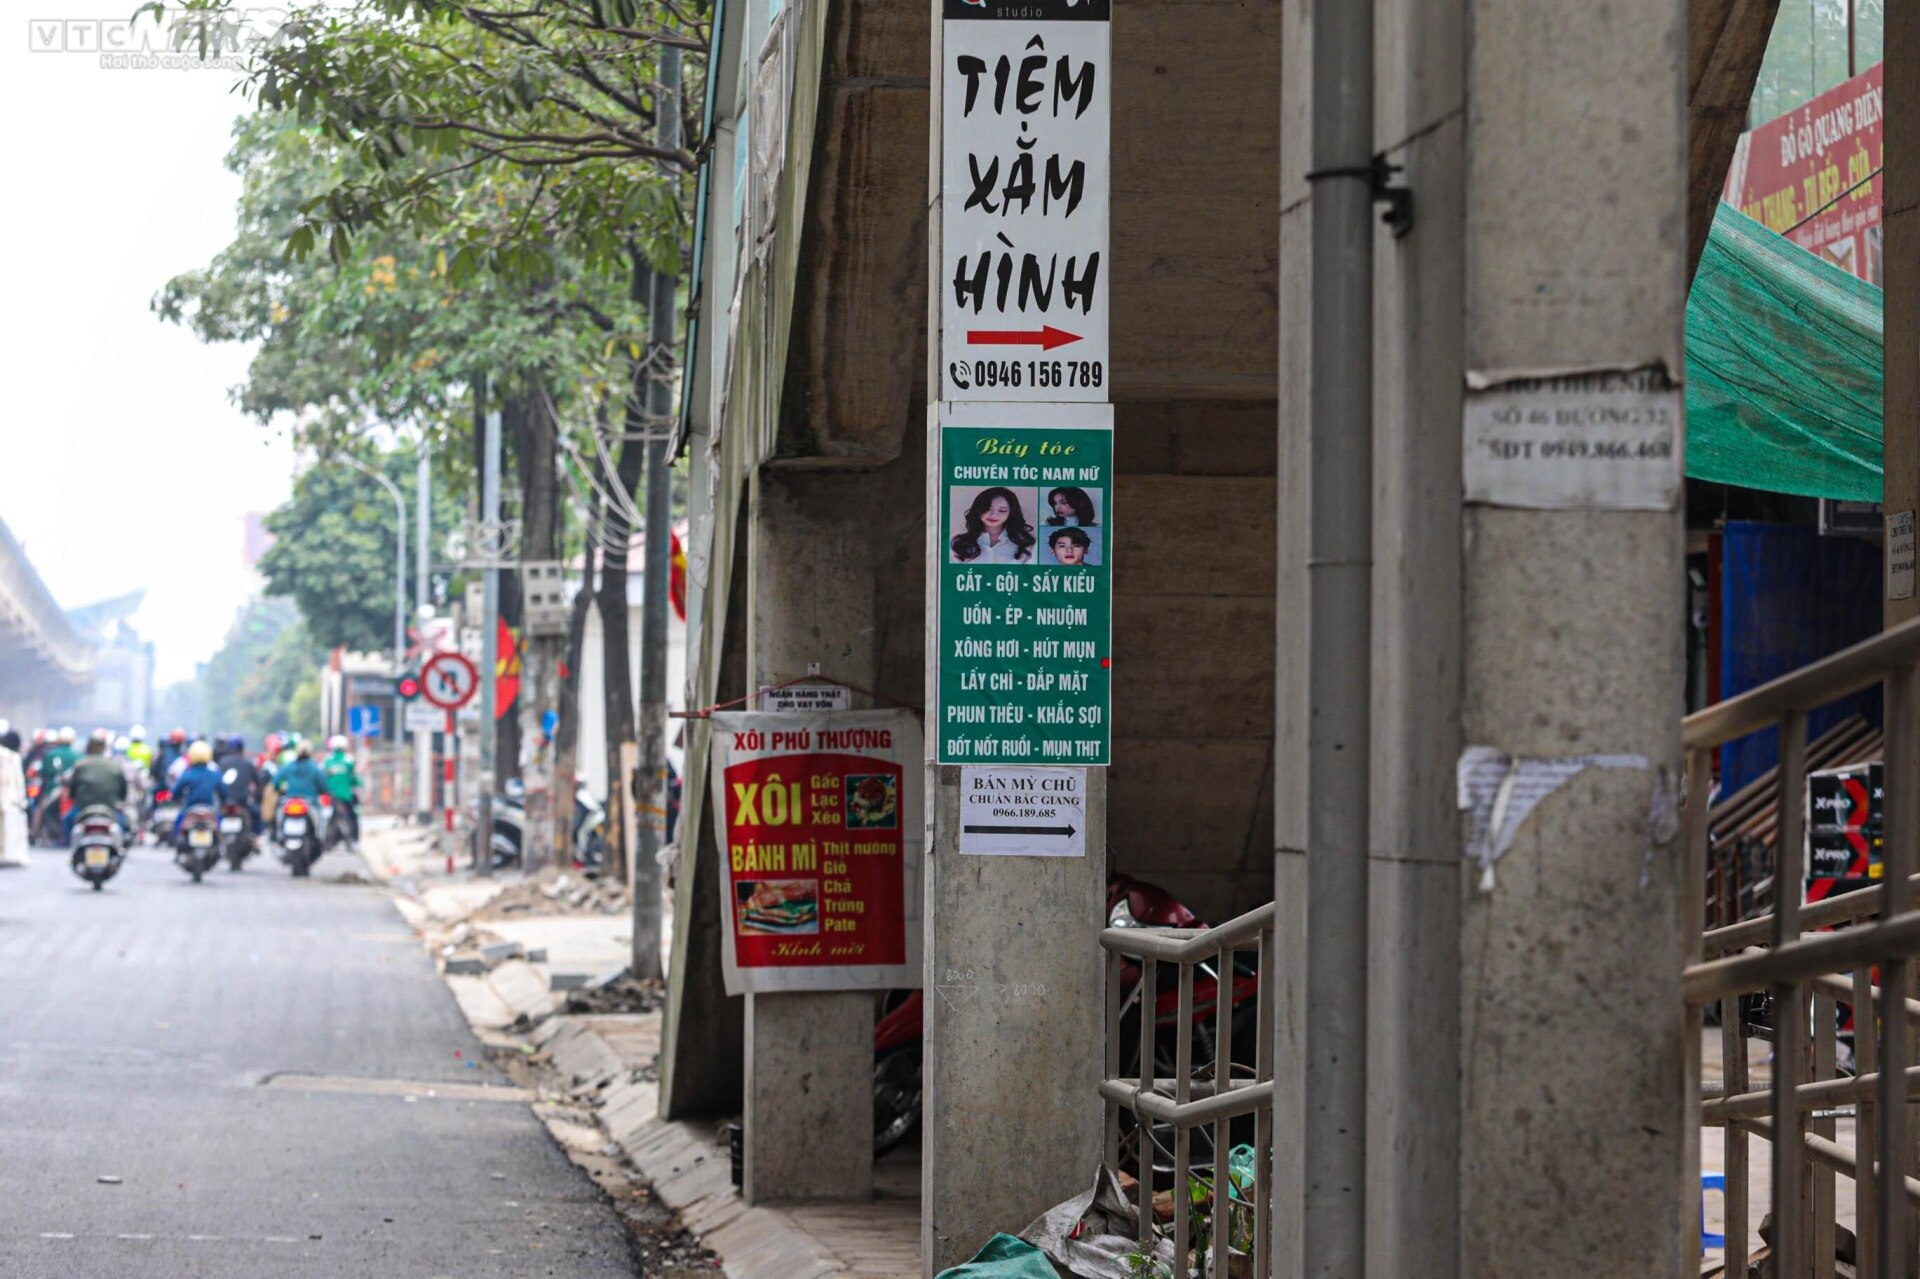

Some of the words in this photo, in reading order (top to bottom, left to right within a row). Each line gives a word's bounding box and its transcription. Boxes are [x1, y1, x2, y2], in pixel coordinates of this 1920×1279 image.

[996, 5, 1043, 18] studio
[957, 34, 1096, 132] TIỆM
[1814, 102, 1854, 157] QUANG
[963, 136, 1086, 220] XĂM
[953, 231, 1100, 317] HÌNH
[974, 360, 1022, 388] 0946
[1027, 360, 1063, 388] 156
[1067, 360, 1103, 388] 789
[1039, 441, 1077, 456] tóc
[953, 464, 1009, 480] CHUYÊN
[1012, 464, 1039, 480] TÓC
[1042, 467, 1075, 482] NAM
[1078, 465, 1101, 482] NỮ
[955, 568, 983, 593] CẮT
[995, 571, 1020, 597] GỘI
[1032, 568, 1060, 593] SẤY
[1063, 568, 1096, 594] KIỂU
[962, 601, 992, 626] UỐN
[1005, 603, 1023, 626] ÉP
[1036, 604, 1088, 630] NHUỘM
[953, 636, 993, 659] XÔNG
[996, 638, 1020, 659] HƠI
[1033, 636, 1060, 659] HÚT
[1063, 641, 1096, 663] MỤN
[960, 666, 987, 691] LẤY
[989, 669, 1014, 691] CHÌ
[1026, 666, 1055, 692] ĐẮP
[1058, 670, 1089, 695] MẶT
[947, 704, 986, 724] PHUN
[989, 702, 1024, 724] THÊU
[1037, 700, 1075, 725] KHẮC
[1078, 704, 1102, 728] SỢI
[733, 728, 766, 751] XÔI
[771, 726, 811, 751] PHÚ
[816, 727, 892, 753] THƯỢNG
[947, 733, 972, 757] ĐỐT
[974, 733, 1000, 757] NỐT
[1001, 734, 1032, 757] RUỒI
[1042, 740, 1072, 761] MỤN
[1074, 740, 1102, 761] THỊT
[810, 771, 840, 790] Gấc
[973, 774, 1007, 790] BÁN
[1011, 775, 1037, 791] MỲ
[1041, 776, 1078, 792] CHŨ
[732, 773, 803, 827] XÔI
[810, 793, 839, 810] Lạc
[992, 807, 1057, 818] 0966.189.685
[1041, 796, 1081, 806] GIANG
[731, 838, 786, 873] BÁNH
[791, 837, 818, 871] MÌ
[822, 841, 850, 858] Thịt
[824, 918, 857, 932] Pate
